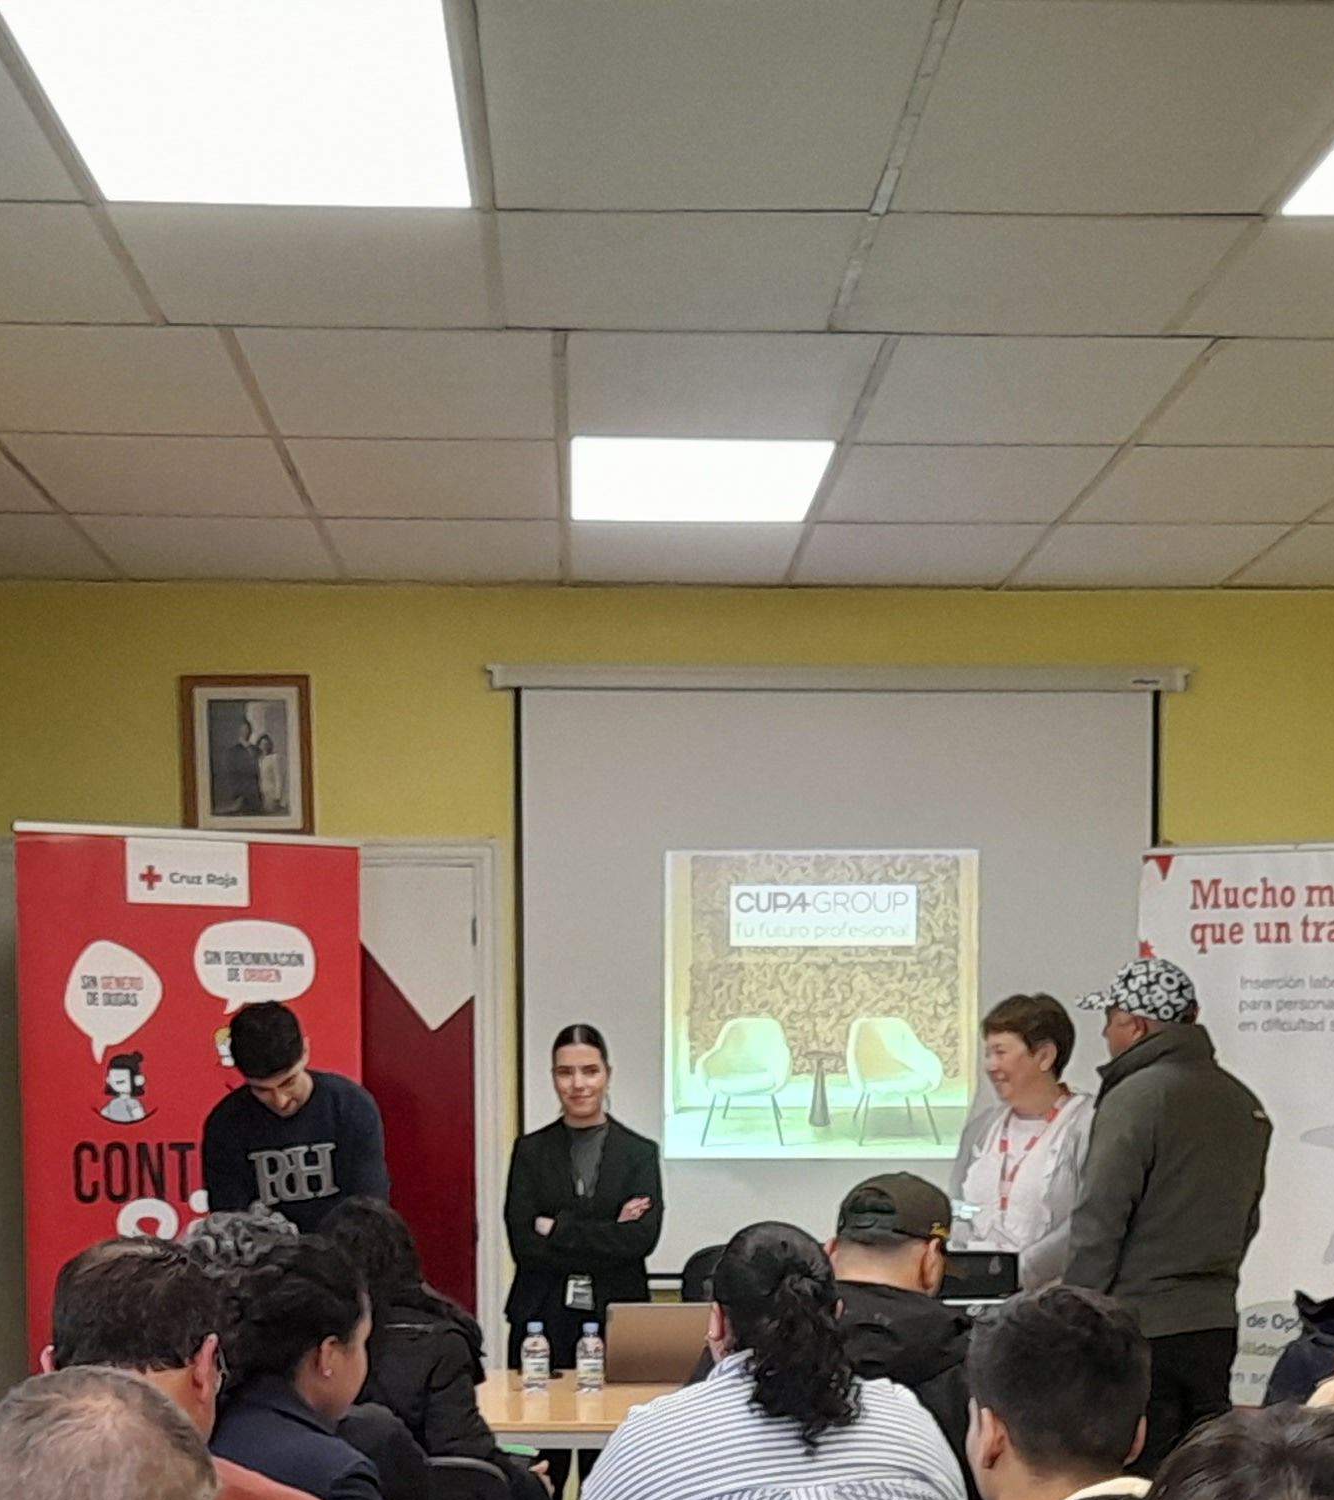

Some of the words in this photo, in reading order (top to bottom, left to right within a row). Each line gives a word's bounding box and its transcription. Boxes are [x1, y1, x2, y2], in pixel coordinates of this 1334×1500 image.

[169, 871, 202, 886] Cruz
[206, 873, 238, 889] Roja
[1190, 877, 1296, 910] Mucho
[735, 921, 756, 938] Tu
[759, 921, 809, 938] futuro
[814, 920, 910, 939] profesional
[1190, 922, 1244, 954] que
[1254, 921, 1291, 944] un
[1240, 975, 1305, 990] Inserción
[1239, 1000, 1272, 1013] para
[1237, 1021, 1257, 1032] en
[73, 1141, 195, 1204] CONT
